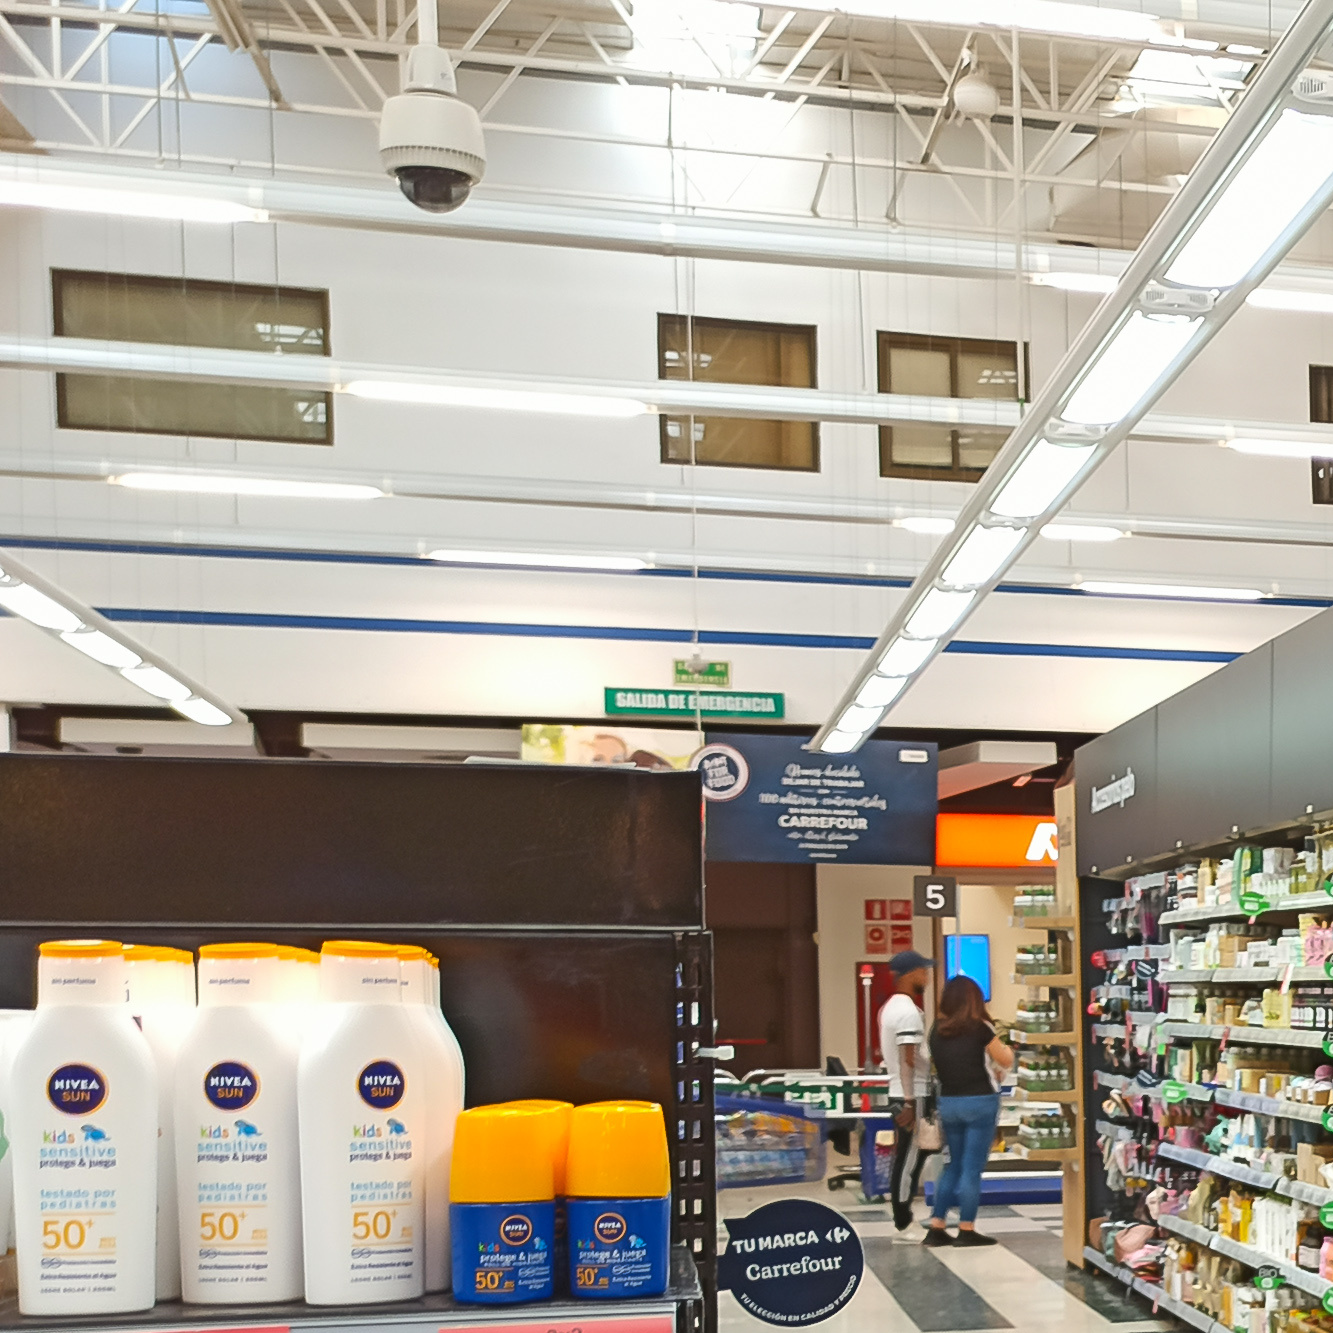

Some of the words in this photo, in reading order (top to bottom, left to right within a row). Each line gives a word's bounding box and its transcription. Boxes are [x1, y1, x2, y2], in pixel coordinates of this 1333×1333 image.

[615, 692, 665, 710] SALIDA
[668, 693, 686, 711] DE
[689, 693, 776, 713] EMERGENCIA
[778, 815, 868, 829] CARREFOUR
[925, 886, 945, 909] 5
[54, 1078, 100, 1090] NIVEA
[210, 1076, 251, 1087] NIVEA
[364, 1074, 400, 1086] NIVEA
[62, 1091, 90, 1101] SUN
[217, 1087, 243, 1098] SUN
[371, 1087, 394, 1097] SUN
[43, 1130, 75, 1144] kids
[40, 1145, 116, 1157] sensitive
[732, 1239, 756, 1253] TU
[758, 1230, 819, 1250] MARCA
[518, 1251, 526, 1260] &
[746, 1256, 842, 1281] Carrefour
